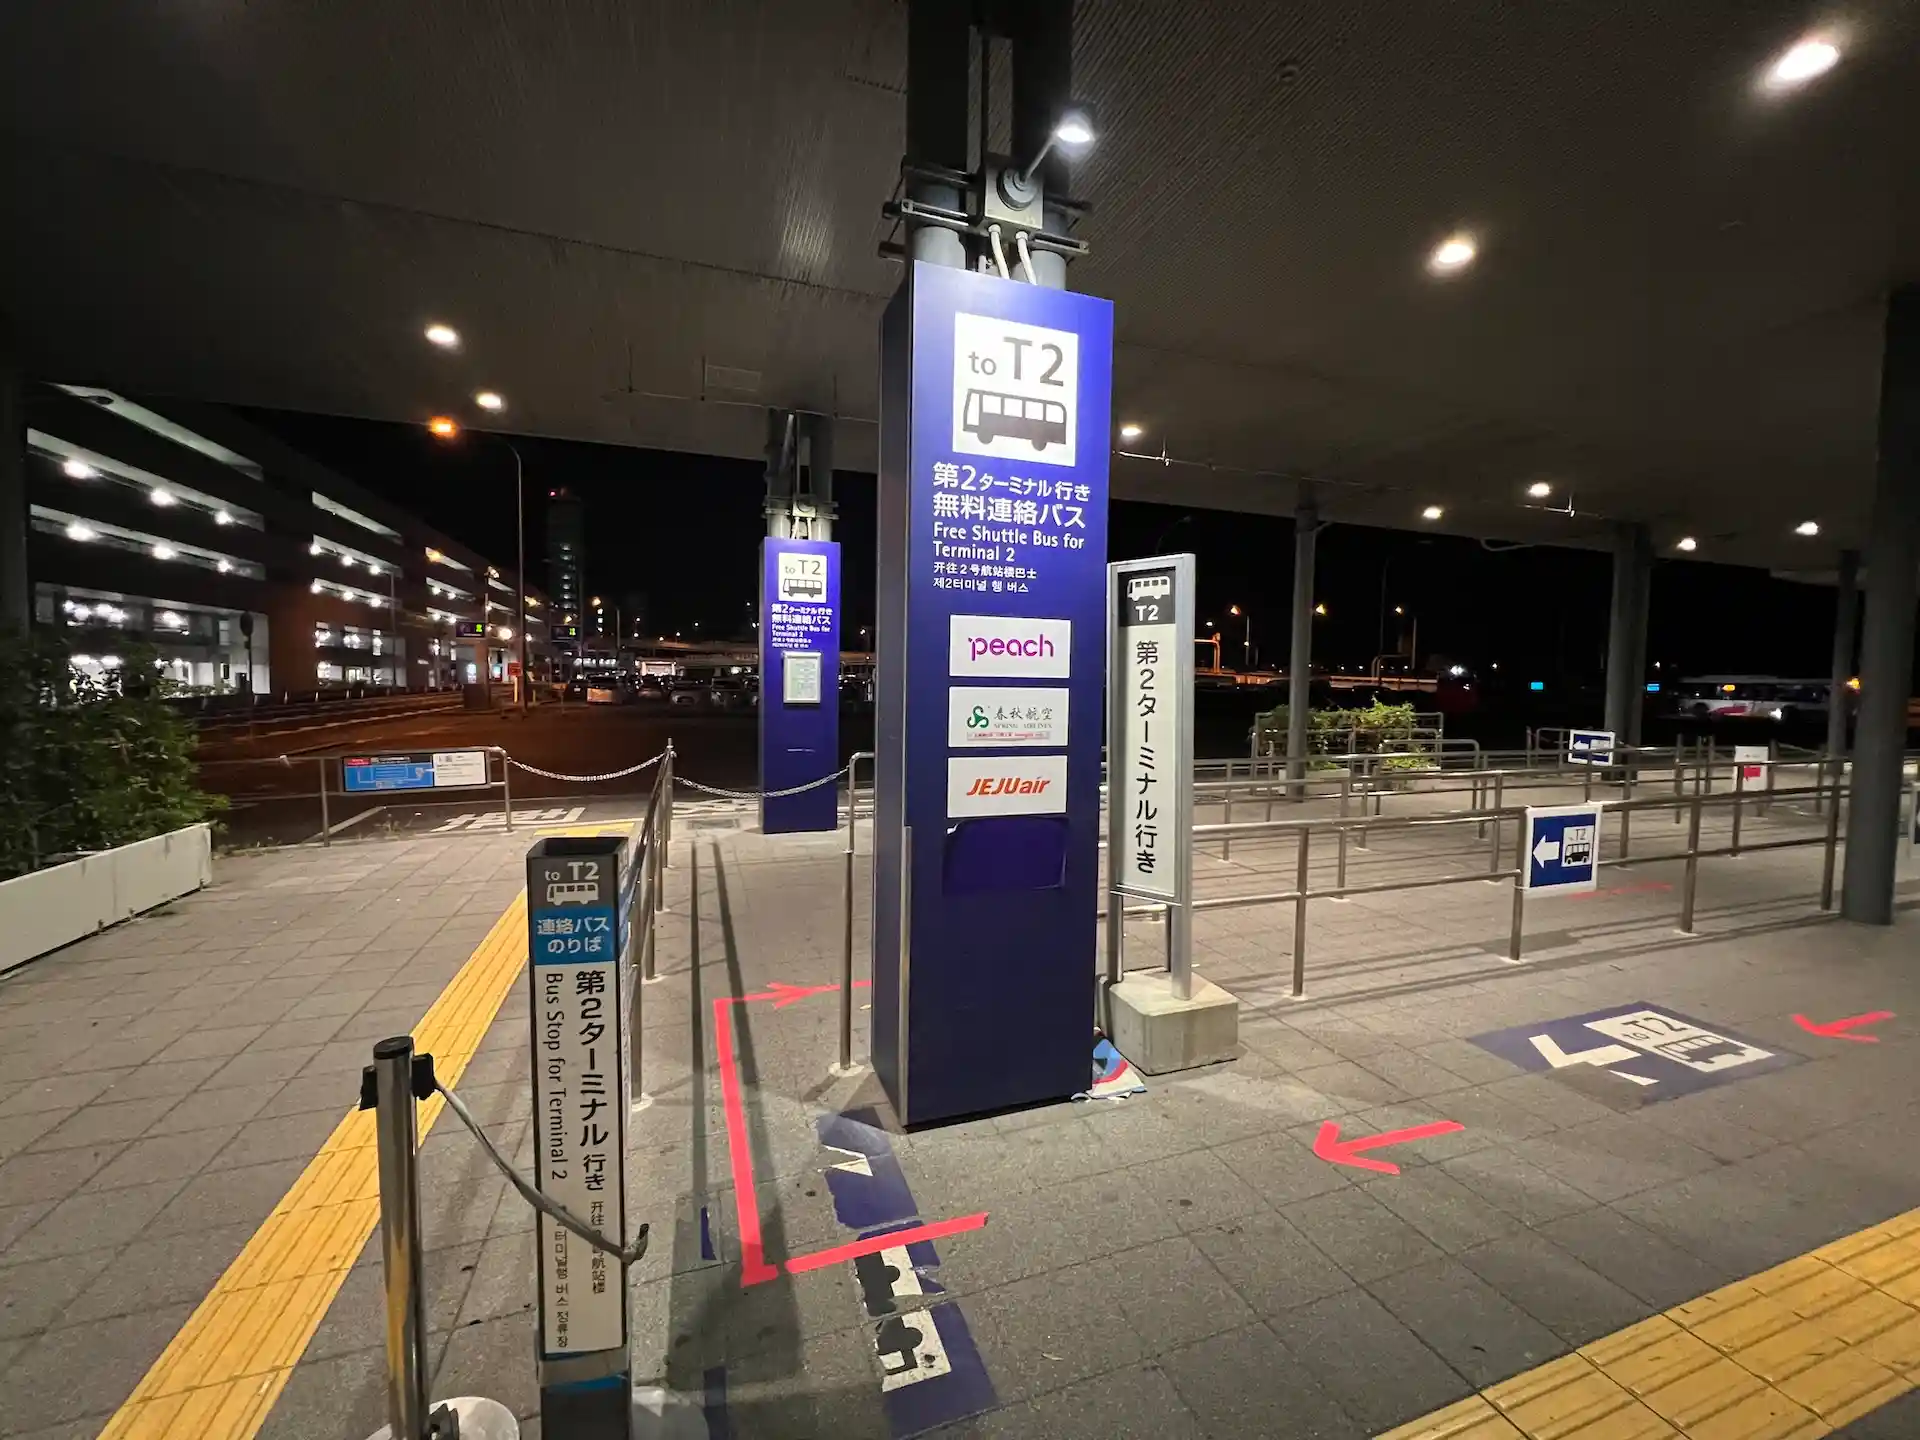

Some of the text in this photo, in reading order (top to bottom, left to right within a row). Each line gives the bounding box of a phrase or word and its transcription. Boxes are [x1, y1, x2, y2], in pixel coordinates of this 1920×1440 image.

[967, 336, 1064, 387] to T2
[932, 461, 1091, 502] 第2ターミナル行き
[932, 491, 1086, 529] 無料連絡バス
[933, 522, 1085, 549] Free Shuttle Bus for
[933, 540, 1015, 562] Terminal 2
[784, 560, 821, 576] to T2
[932, 577, 1029, 593] 제2터미널 행 버스
[1135, 604, 1159, 621] T2
[786, 624, 808, 632] Shuttle
[968, 633, 1054, 662] peach
[993, 705, 1053, 721] 春秋航空
[1135, 640, 1159, 874] 第2ターミナル行き
[966, 775, 1050, 796] JEJUair
[544, 861, 600, 881] to T2
[536, 916, 610, 935] 連絡バス
[547, 936, 603, 954] のりば
[1620, 1017, 1689, 1036] T2
[543, 972, 568, 1180] Bus Stop for Terminal 2
[575, 969, 609, 1191] 第2ターミナル行き
[555, 1282, 569, 1307] 버스
[556, 1310, 569, 1348] 정류장
